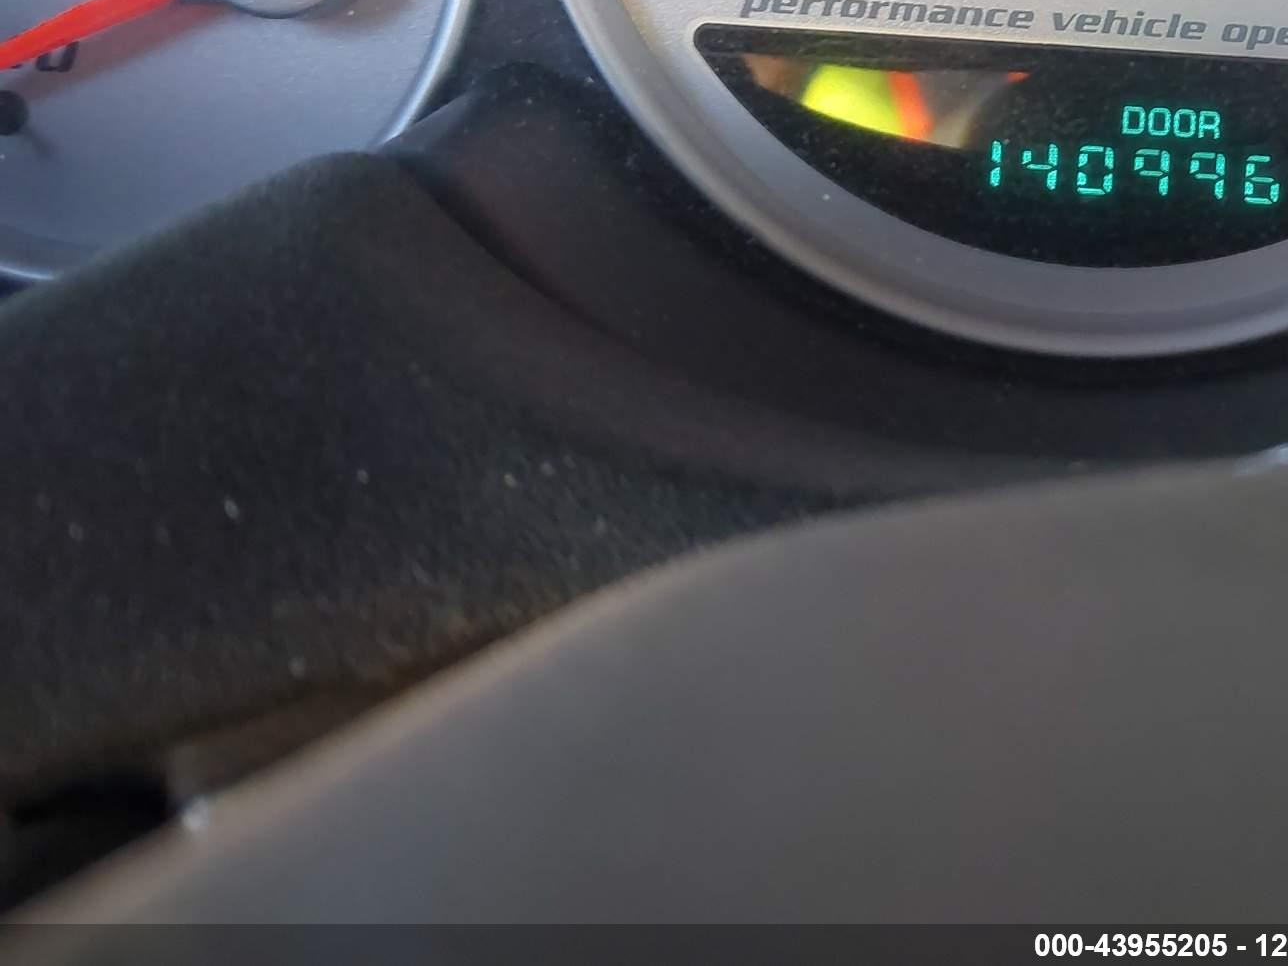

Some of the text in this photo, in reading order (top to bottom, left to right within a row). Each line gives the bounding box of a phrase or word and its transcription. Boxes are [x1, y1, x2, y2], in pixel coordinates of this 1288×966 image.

[1052, 9, 1207, 42] vehicle
[1121, 105, 1221, 139] DOOR
[989, 140, 1280, 204] 140996
